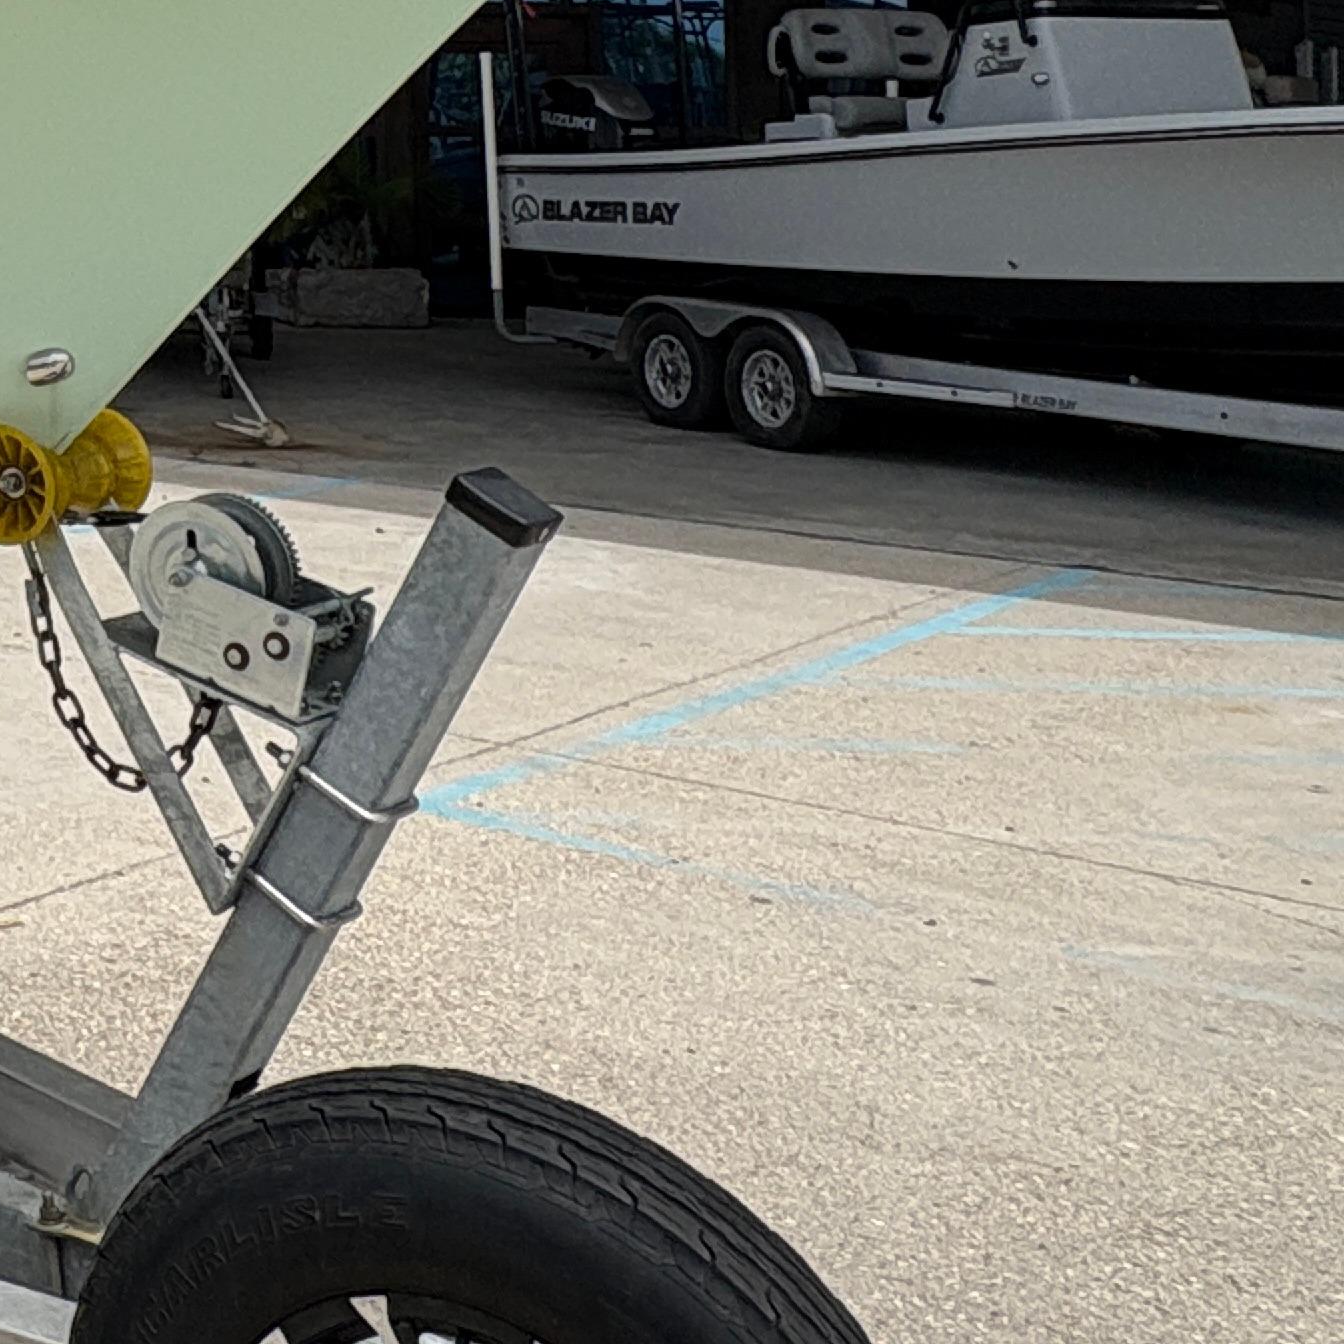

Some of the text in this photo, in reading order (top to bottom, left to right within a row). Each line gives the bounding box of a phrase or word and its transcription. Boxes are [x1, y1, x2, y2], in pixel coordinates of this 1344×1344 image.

[540, 109, 597, 133] SUZUKI
[542, 198, 682, 226] BLAZER BAY
